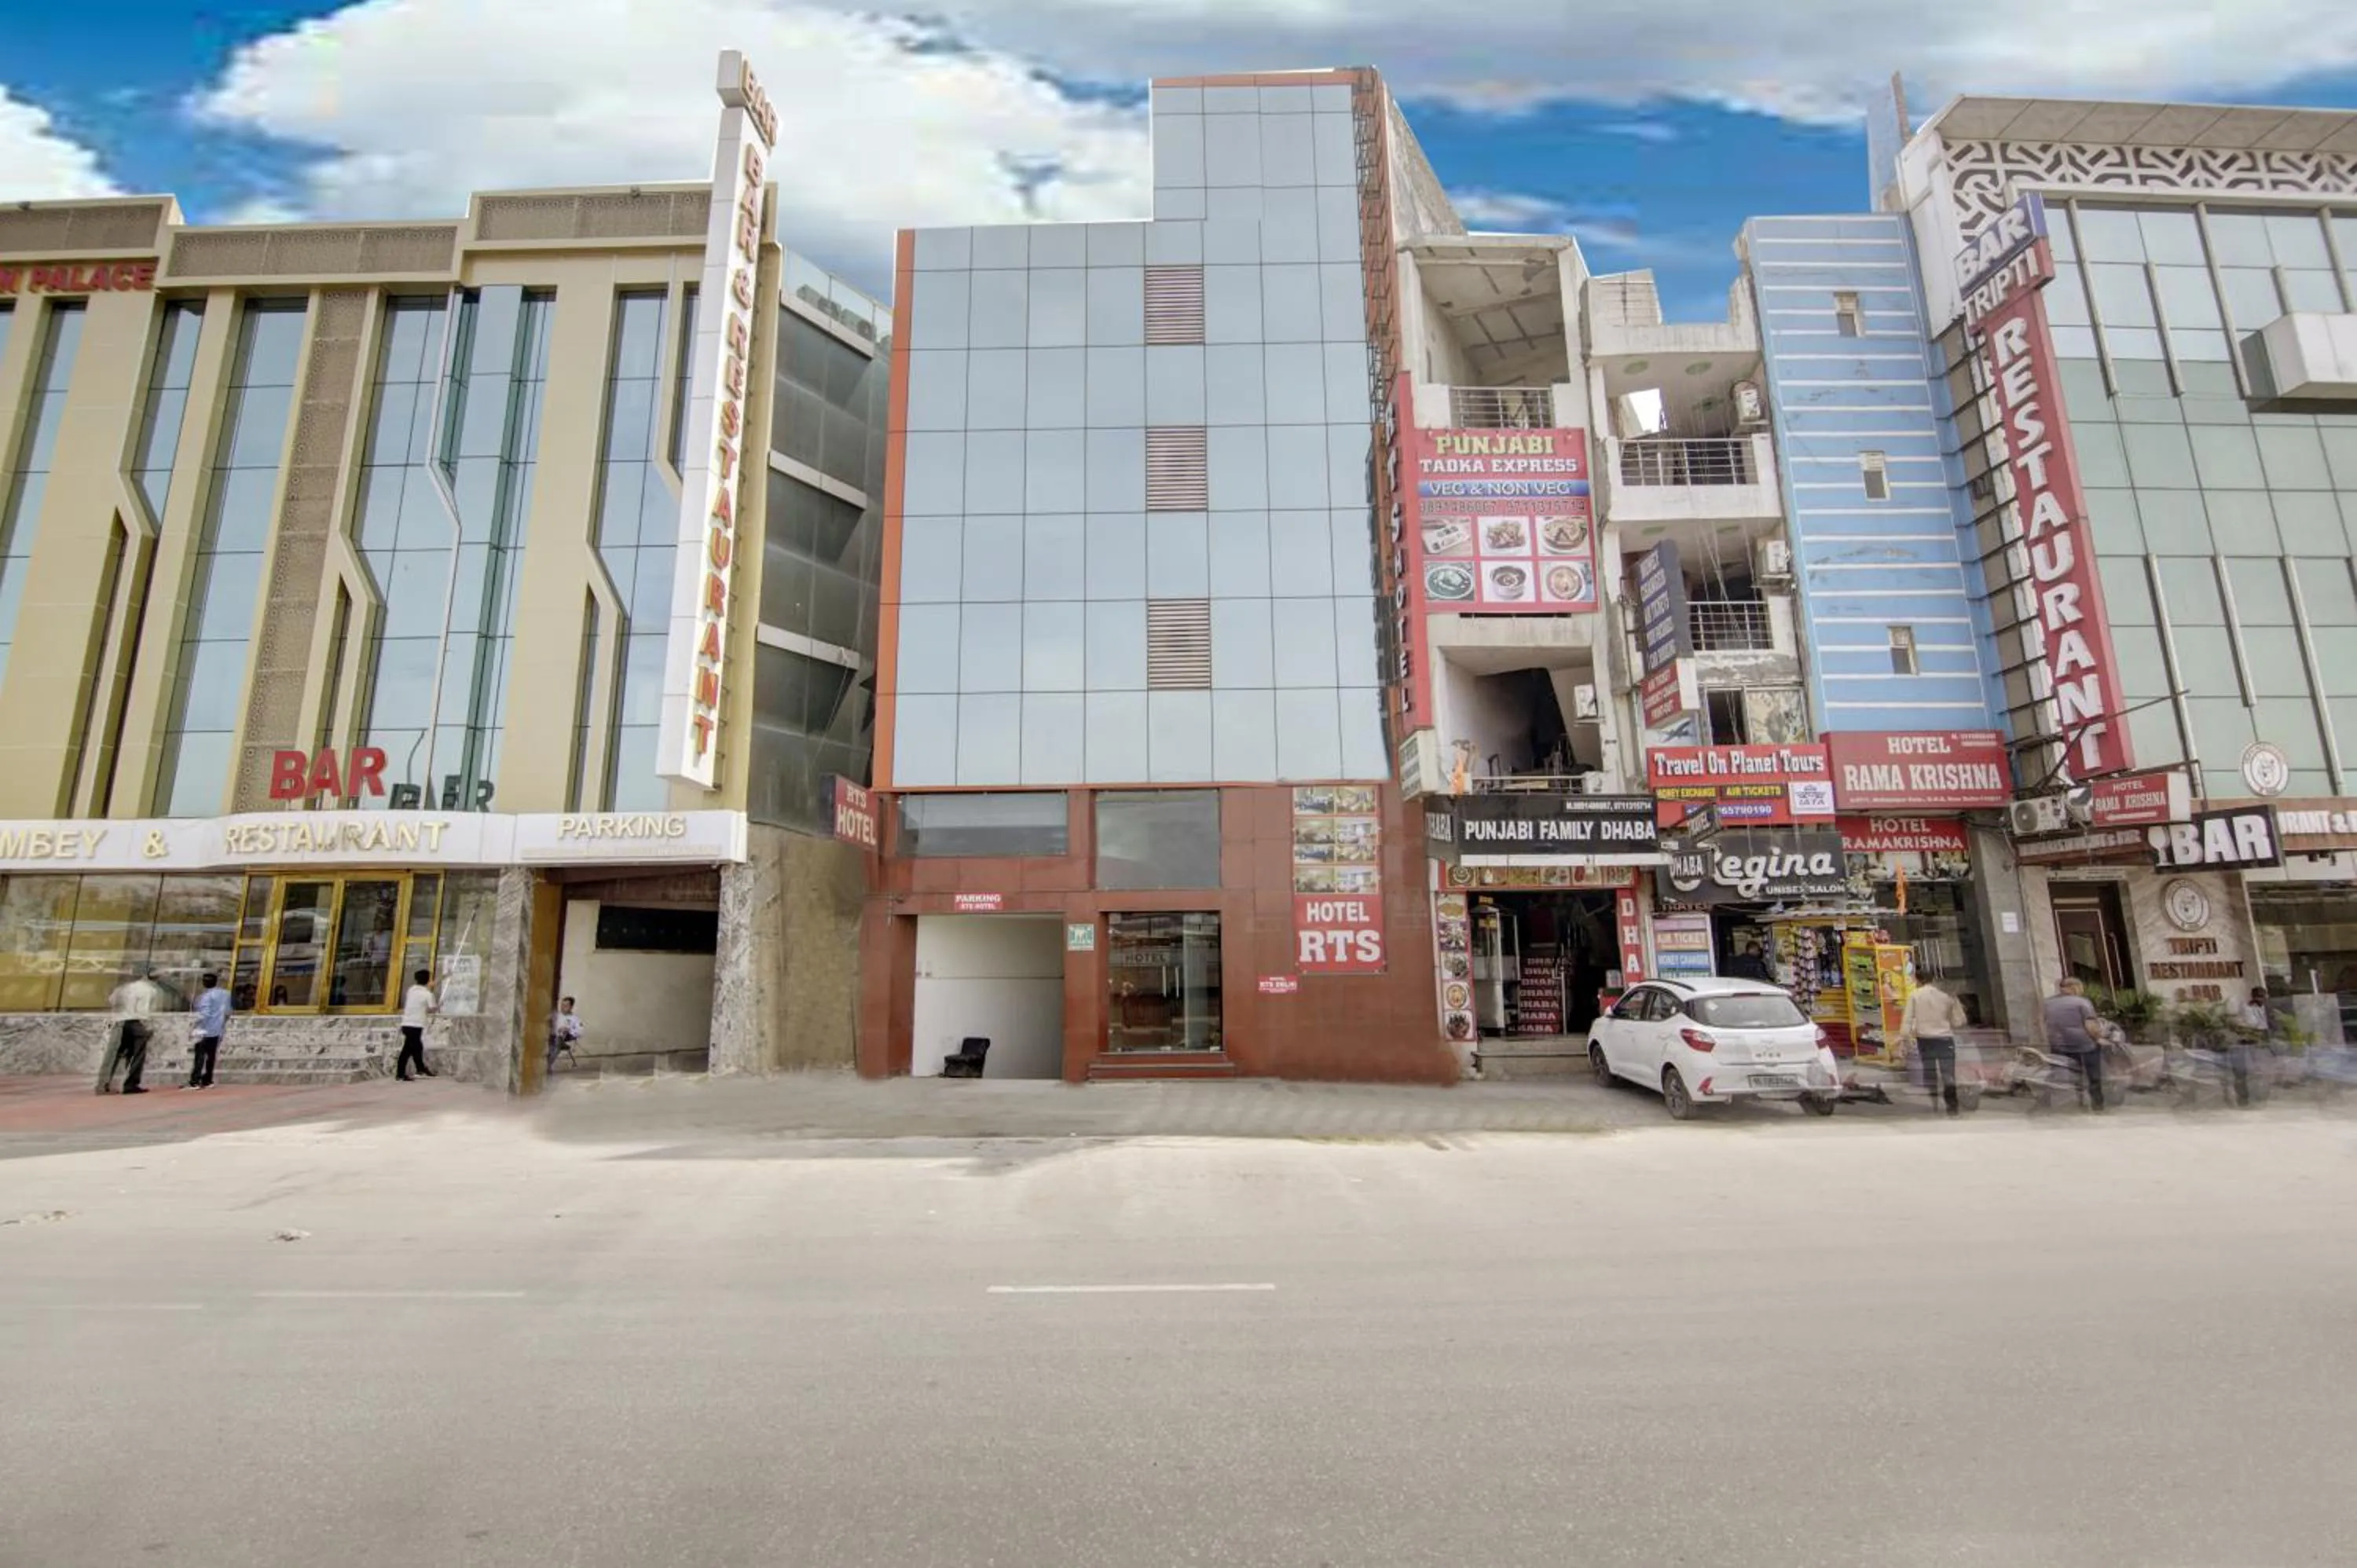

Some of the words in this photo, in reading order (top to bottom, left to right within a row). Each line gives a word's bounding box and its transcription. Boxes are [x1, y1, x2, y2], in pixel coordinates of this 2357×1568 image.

[742, 59, 778, 147] BAR
[1954, 207, 2031, 288] BAR
[29, 262, 155, 293] PALACE
[1963, 247, 2040, 327] TRIPTI
[1435, 436, 1555, 455] PUNJABI
[1492, 458, 1578, 472] EXPRESS
[1429, 482, 1465, 495] VEG
[1470, 483, 1484, 495] &
[1487, 482, 1530, 495] NON
[1533, 482, 1572, 495] VEG
[692, 312, 747, 758] RESTAURANT
[1992, 316, 2107, 771] RESTAURANT
[1886, 735, 1952, 755] HOTEL
[269, 746, 387, 800] BAR
[1654, 752, 1704, 775] Travel
[1707, 750, 1728, 774] On
[1729, 750, 1777, 774] Planet
[1780, 749, 1825, 772] Tours
[1843, 764, 1905, 792] RAMA
[1908, 763, 2003, 791] KRISHNA
[2113, 779, 2145, 791] HOTEL
[846, 784, 867, 810] RTS
[1725, 786, 1743, 797] AIR
[1743, 786, 1781, 796] TICKETS
[2095, 797, 2120, 811] RAMA
[2124, 791, 2166, 810] KRISHNA
[556, 815, 687, 840] PARKING
[836, 803, 878, 847] HOTEL
[1464, 820, 1533, 841] PUNJABI
[1539, 820, 1595, 840] FAMILY
[1600, 820, 1657, 840] DHABA
[1870, 818, 1932, 833] HOTEL
[142, 829, 169, 859] &
[225, 820, 450, 855] RESTAURANT
[1842, 836, 1964, 849] RAMAKRISHNA
[2168, 815, 2274, 865] BAR
[955, 893, 1002, 903] PARKING
[1809, 884, 1846, 894] SALON
[1306, 901, 1371, 923] HOTEL
[1298, 929, 1382, 963] RTS
[1621, 898, 1644, 986] DHA
[1124, 951, 1170, 965] HOTEL
[2149, 960, 2244, 979] RESTAURANT
